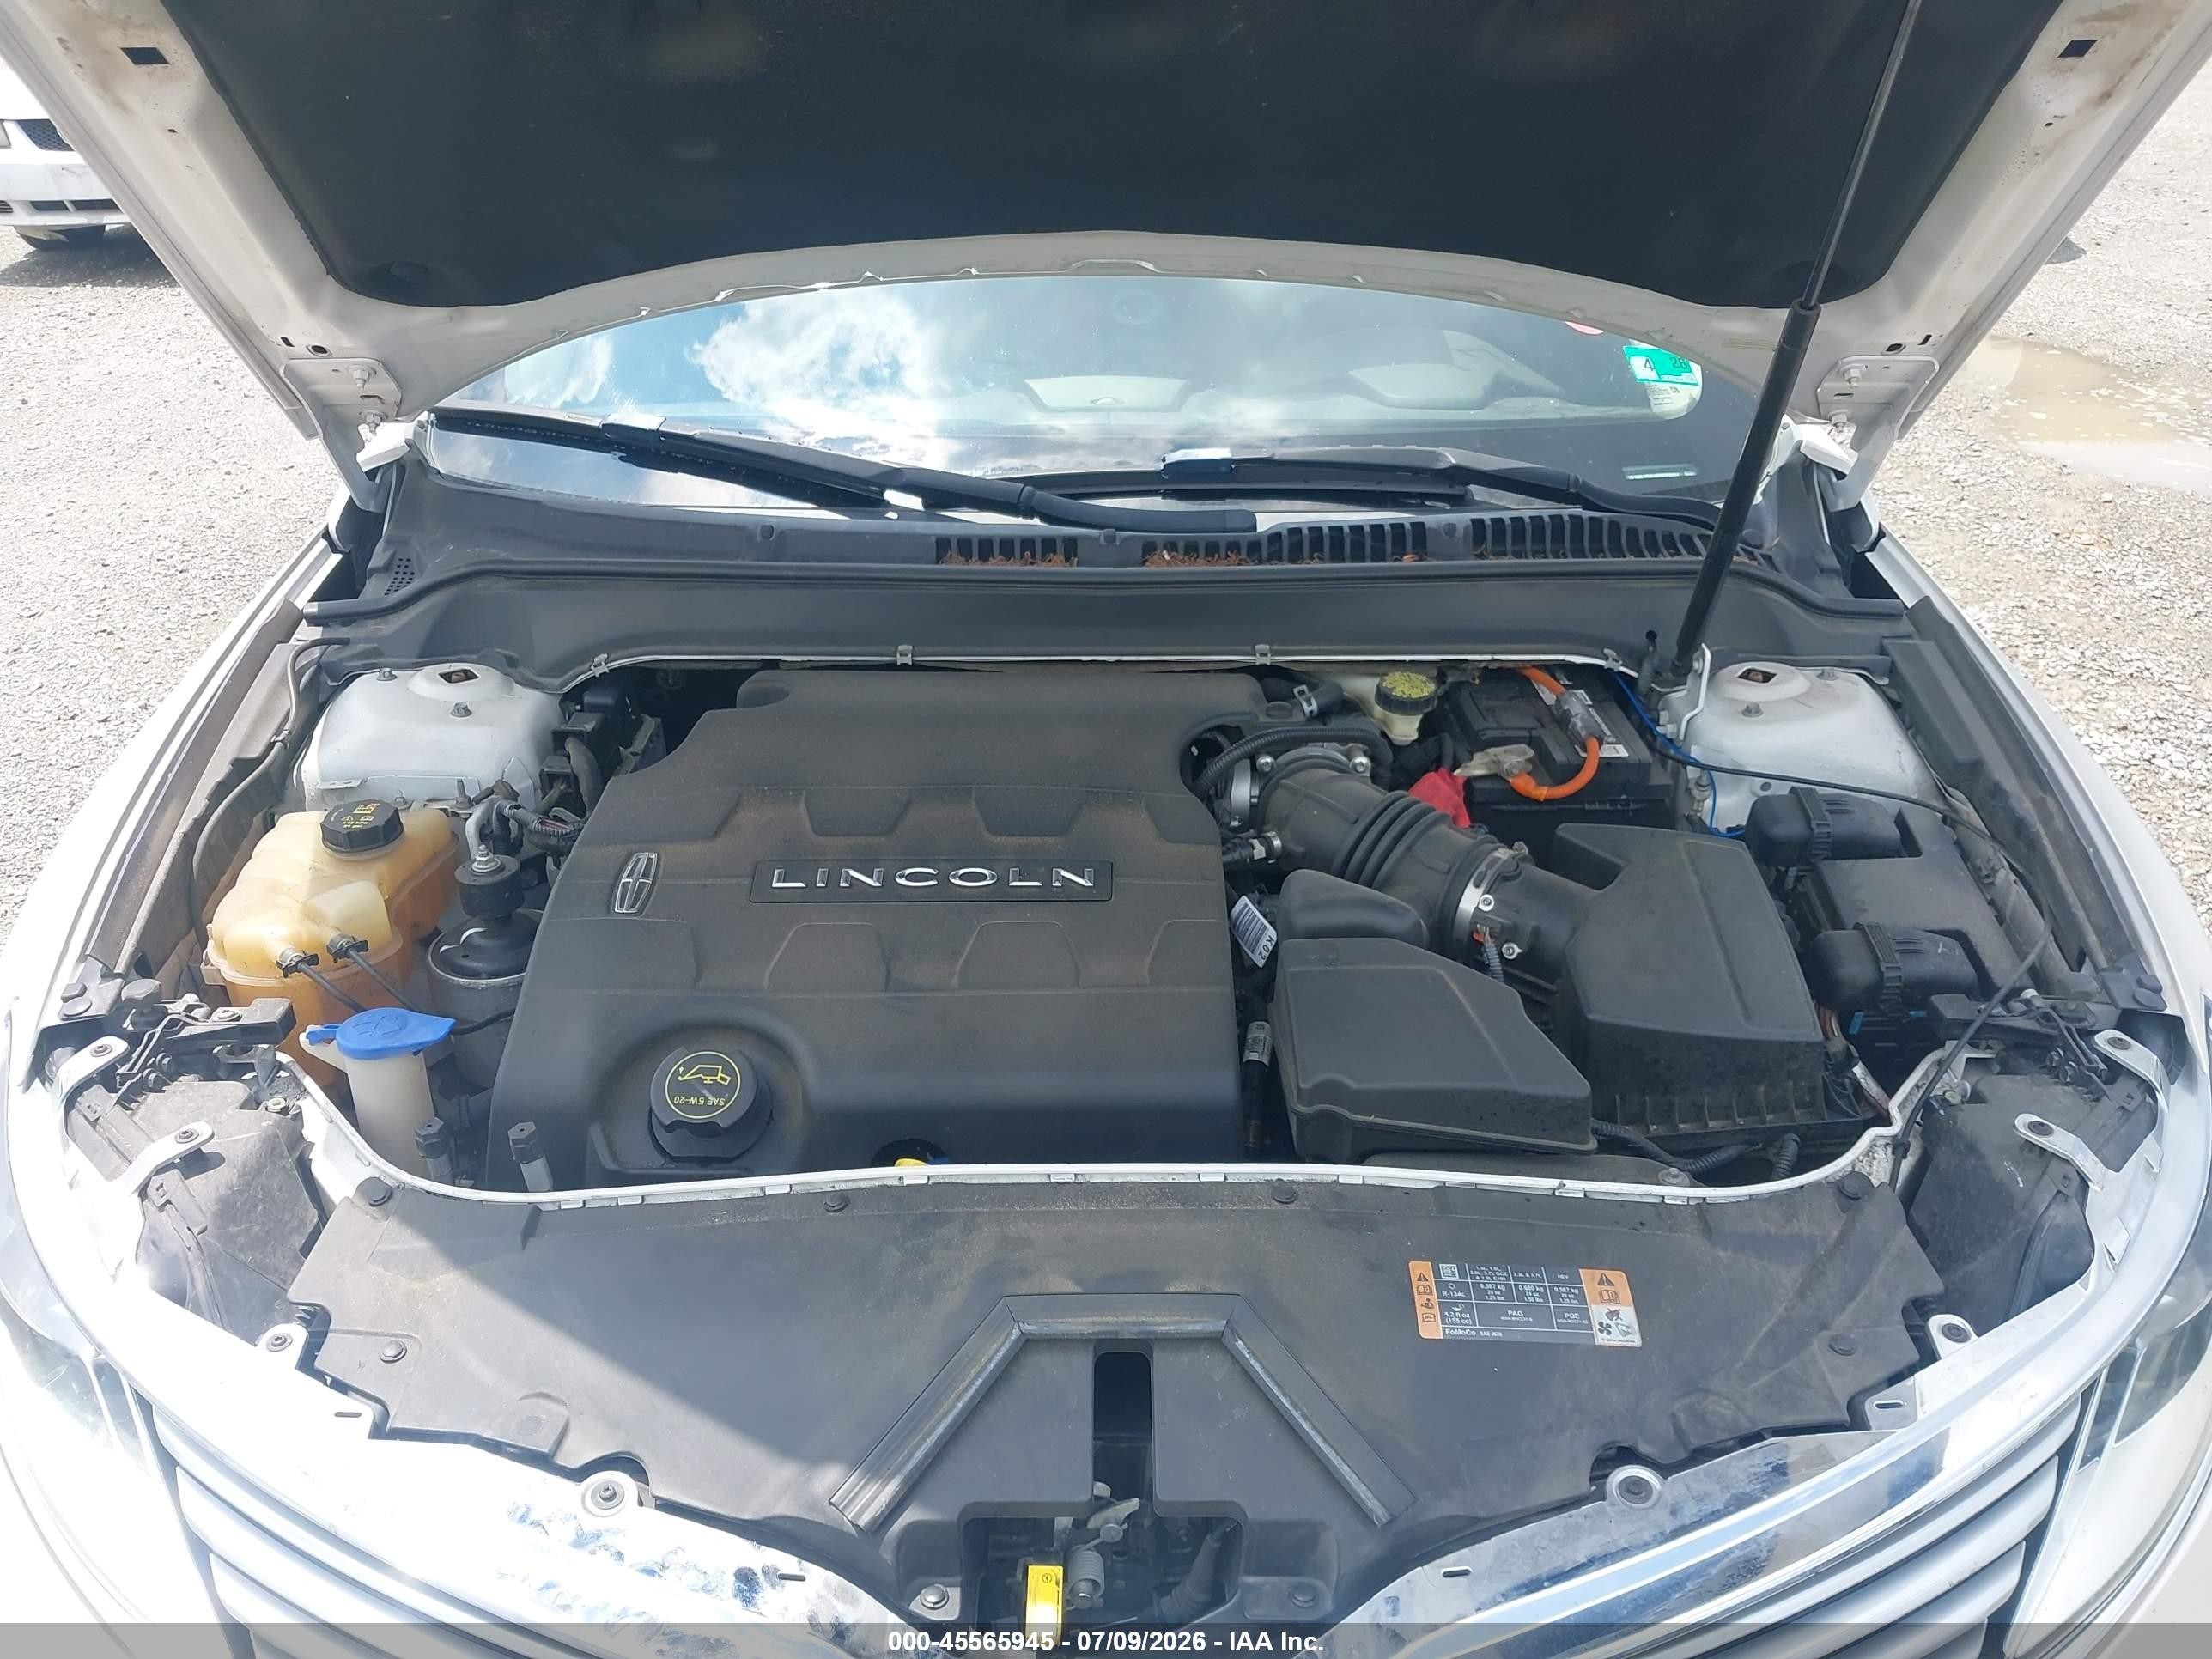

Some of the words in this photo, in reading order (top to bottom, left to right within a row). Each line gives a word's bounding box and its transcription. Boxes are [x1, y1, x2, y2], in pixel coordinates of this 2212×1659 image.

[1644, 357, 1653, 371] 4
[771, 866, 1094, 888] LINCOLN
[673, 1096, 705, 1105] 5W-20
[707, 1097, 726, 1106] SAE
